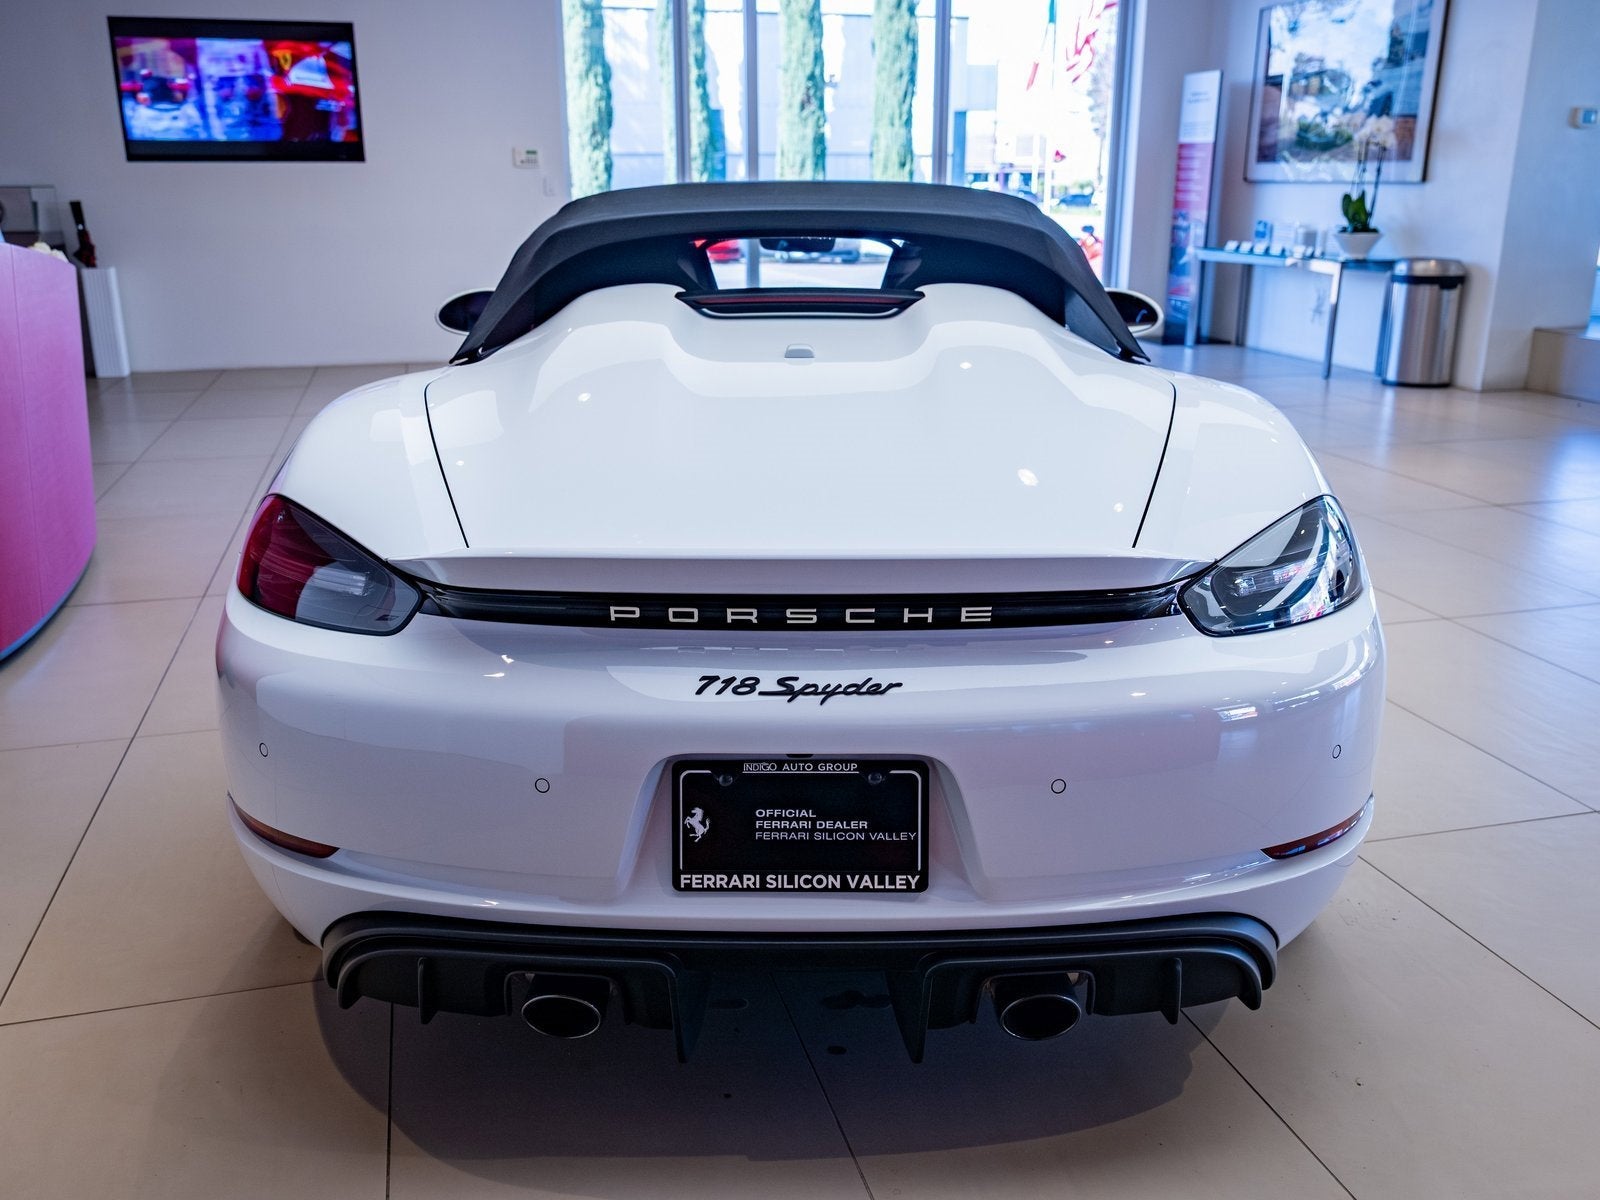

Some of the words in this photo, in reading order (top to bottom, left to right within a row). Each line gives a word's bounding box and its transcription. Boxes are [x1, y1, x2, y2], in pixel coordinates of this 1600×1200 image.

[609, 606, 993, 624] PORSCHE
[694, 675, 761, 696] 718
[757, 676, 904, 706] Spyder
[743, 762, 778, 772] INDIGO
[782, 762, 814, 772] AUTO
[817, 762, 858, 772] GROUP
[755, 809, 817, 818] OFFICIAL
[755, 820, 812, 829] FERRARI
[817, 820, 868, 829] DEALER
[755, 831, 810, 841] FERRARI
[813, 831, 865, 841] SILICON
[869, 831, 917, 841] VALLEY
[680, 874, 760, 889] FERRARI
[765, 874, 841, 889] SILICON
[846, 874, 921, 889] VALLEY
